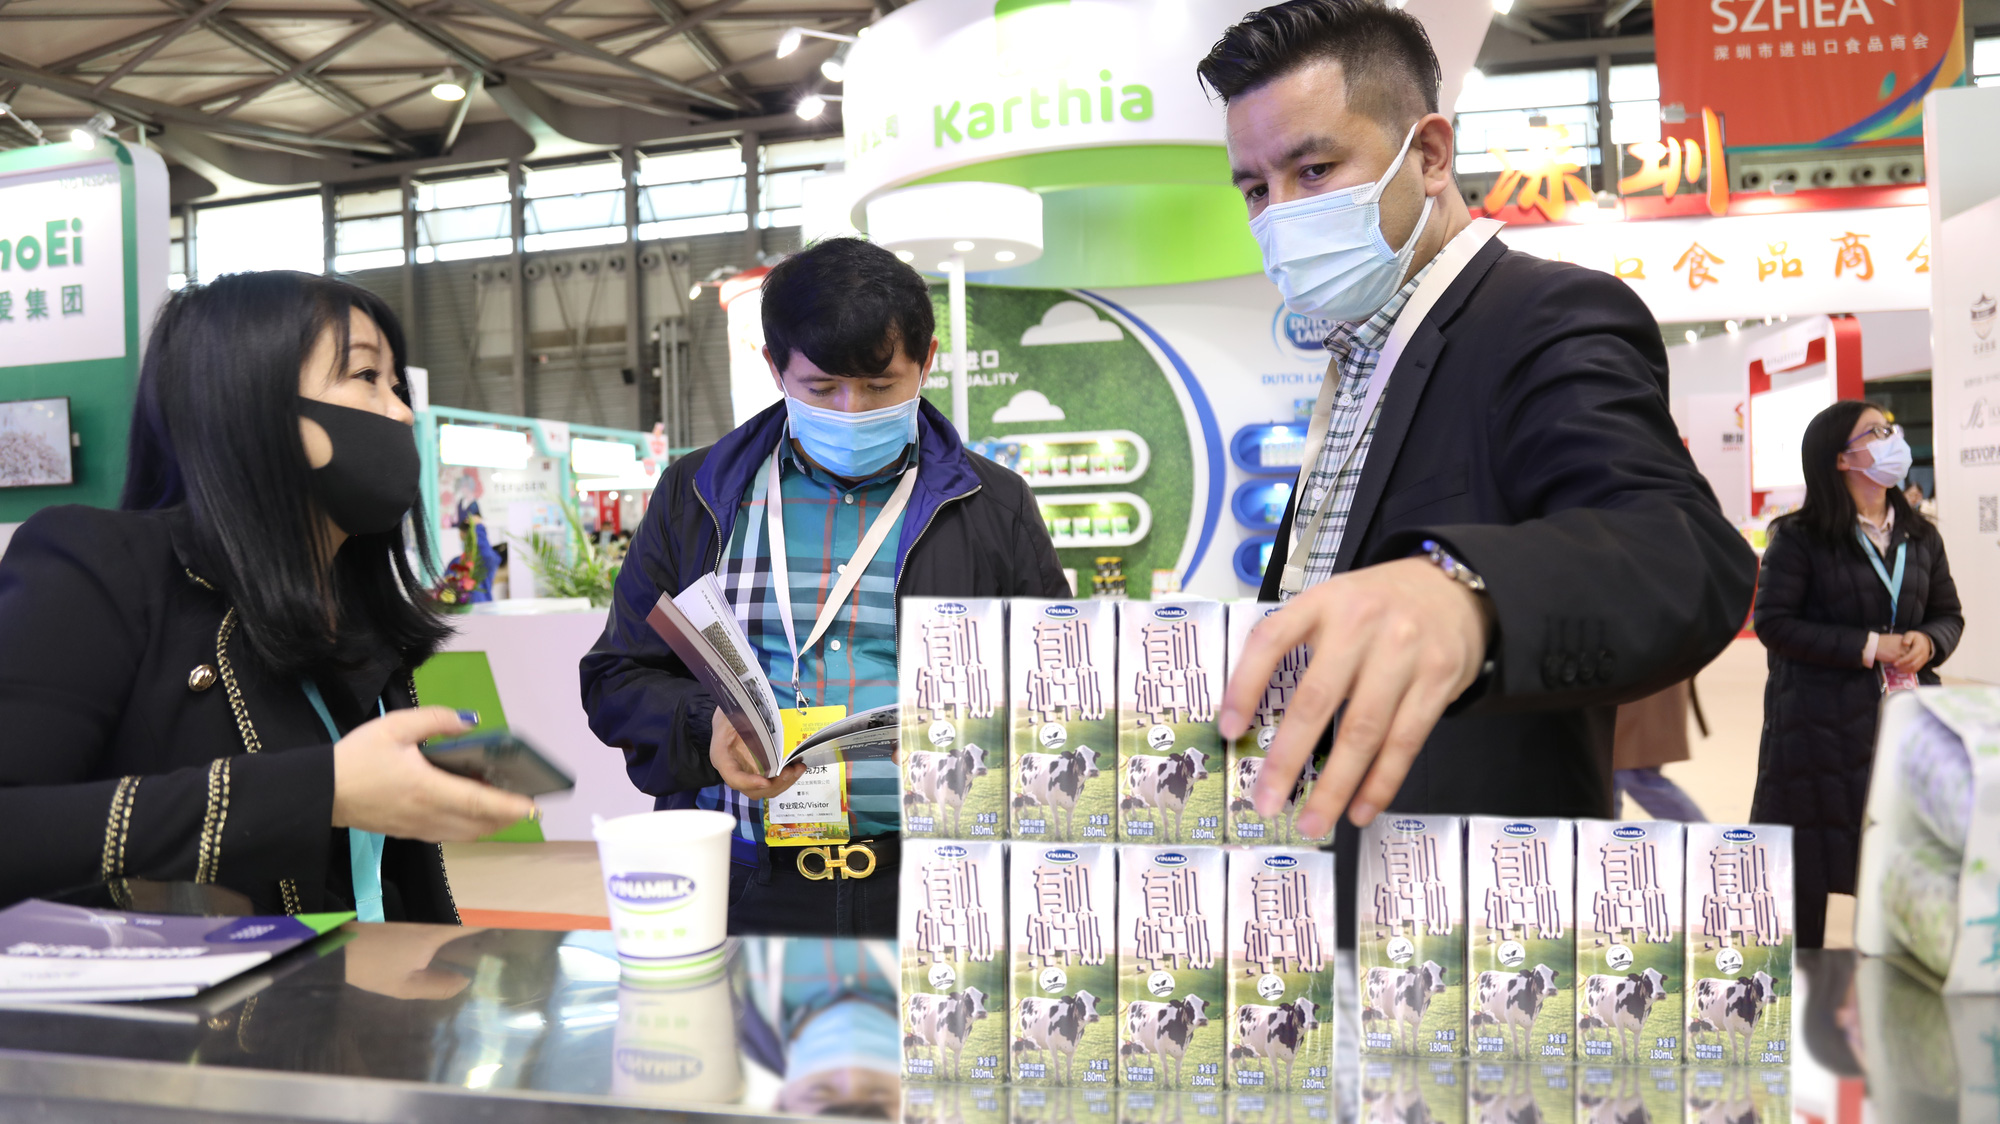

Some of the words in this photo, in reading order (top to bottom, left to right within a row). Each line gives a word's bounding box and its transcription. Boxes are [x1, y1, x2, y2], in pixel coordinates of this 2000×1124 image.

[1711, 0, 1875, 34] SZFIEA
[1713, 31, 1930, 61] 深圳市进出口食品商会
[933, 69, 1155, 148] Karthia
[1485, 107, 1730, 222] 深圳
[1046, 606, 1077, 615] VINAMILK
[1156, 608, 1186, 617] VINAMILK
[921, 617, 983, 670] 有机
[1033, 620, 1093, 670] 有机
[1142, 620, 1201, 672] 有机
[915, 665, 995, 720] 纯牛奶
[1026, 667, 1105, 722] 纯牛奶
[1134, 668, 1214, 725] 纯牛奶
[977, 812, 998, 824] 净含量
[1089, 814, 1109, 825] 净含量
[1198, 817, 1218, 828] 净含量
[970, 825, 996, 836] 180mL
[1083, 826, 1107, 837] 180mL
[1191, 829, 1216, 840] 180mL
[1505, 826, 1535, 834] VINAMILK
[1614, 829, 1645, 837] VINAMILK
[1723, 832, 1754, 841] VINAMILK
[1046, 852, 1077, 860] VINAMILK
[1156, 855, 1186, 863] VINAMILK
[1265, 858, 1296, 866] VINAMILK
[1380, 834, 1441, 886] 有机
[1491, 838, 1551, 890] 有机
[1600, 842, 1660, 893] 有机
[1710, 844, 1770, 895] 有机
[612, 879, 693, 899] VINAMILK
[921, 860, 983, 912] 有机
[1033, 864, 1093, 915] 有机
[1142, 867, 1201, 919] 有机
[1251, 870, 1311, 922] 有机
[1374, 881, 1453, 938] 纯牛奶
[1485, 885, 1564, 941] 纯牛奶
[1593, 888, 1673, 944] 纯牛奶
[1702, 890, 1783, 948] 纯牛奶
[915, 908, 995, 963] 纯牛奶
[1026, 911, 1105, 967] 纯牛奶
[1134, 915, 1215, 972] 纯牛奶
[1243, 917, 1325, 975] 纯牛奶
[1435, 1030, 1456, 1041] 净含量
[1547, 1033, 1568, 1044] 净含量
[1429, 1042, 1453, 1053] 180mL
[1656, 1038, 1677, 1048] 净含量
[1767, 1041, 1786, 1052] 净含量
[1541, 1045, 1565, 1056] 180mL
[1649, 1049, 1674, 1061] 180mL
[977, 1055, 998, 1067] 净含量
[1760, 1052, 1784, 1064] 180mL
[1089, 1059, 1109, 1070] 净含量
[1198, 1063, 1218, 1074] 净含量
[970, 1068, 996, 1079] 180mL
[1083, 1071, 1107, 1083] 180mL
[1309, 1067, 1328, 1077] 净含量
[1191, 1075, 1216, 1086] 180mL
[1302, 1078, 1326, 1089] 180mL
